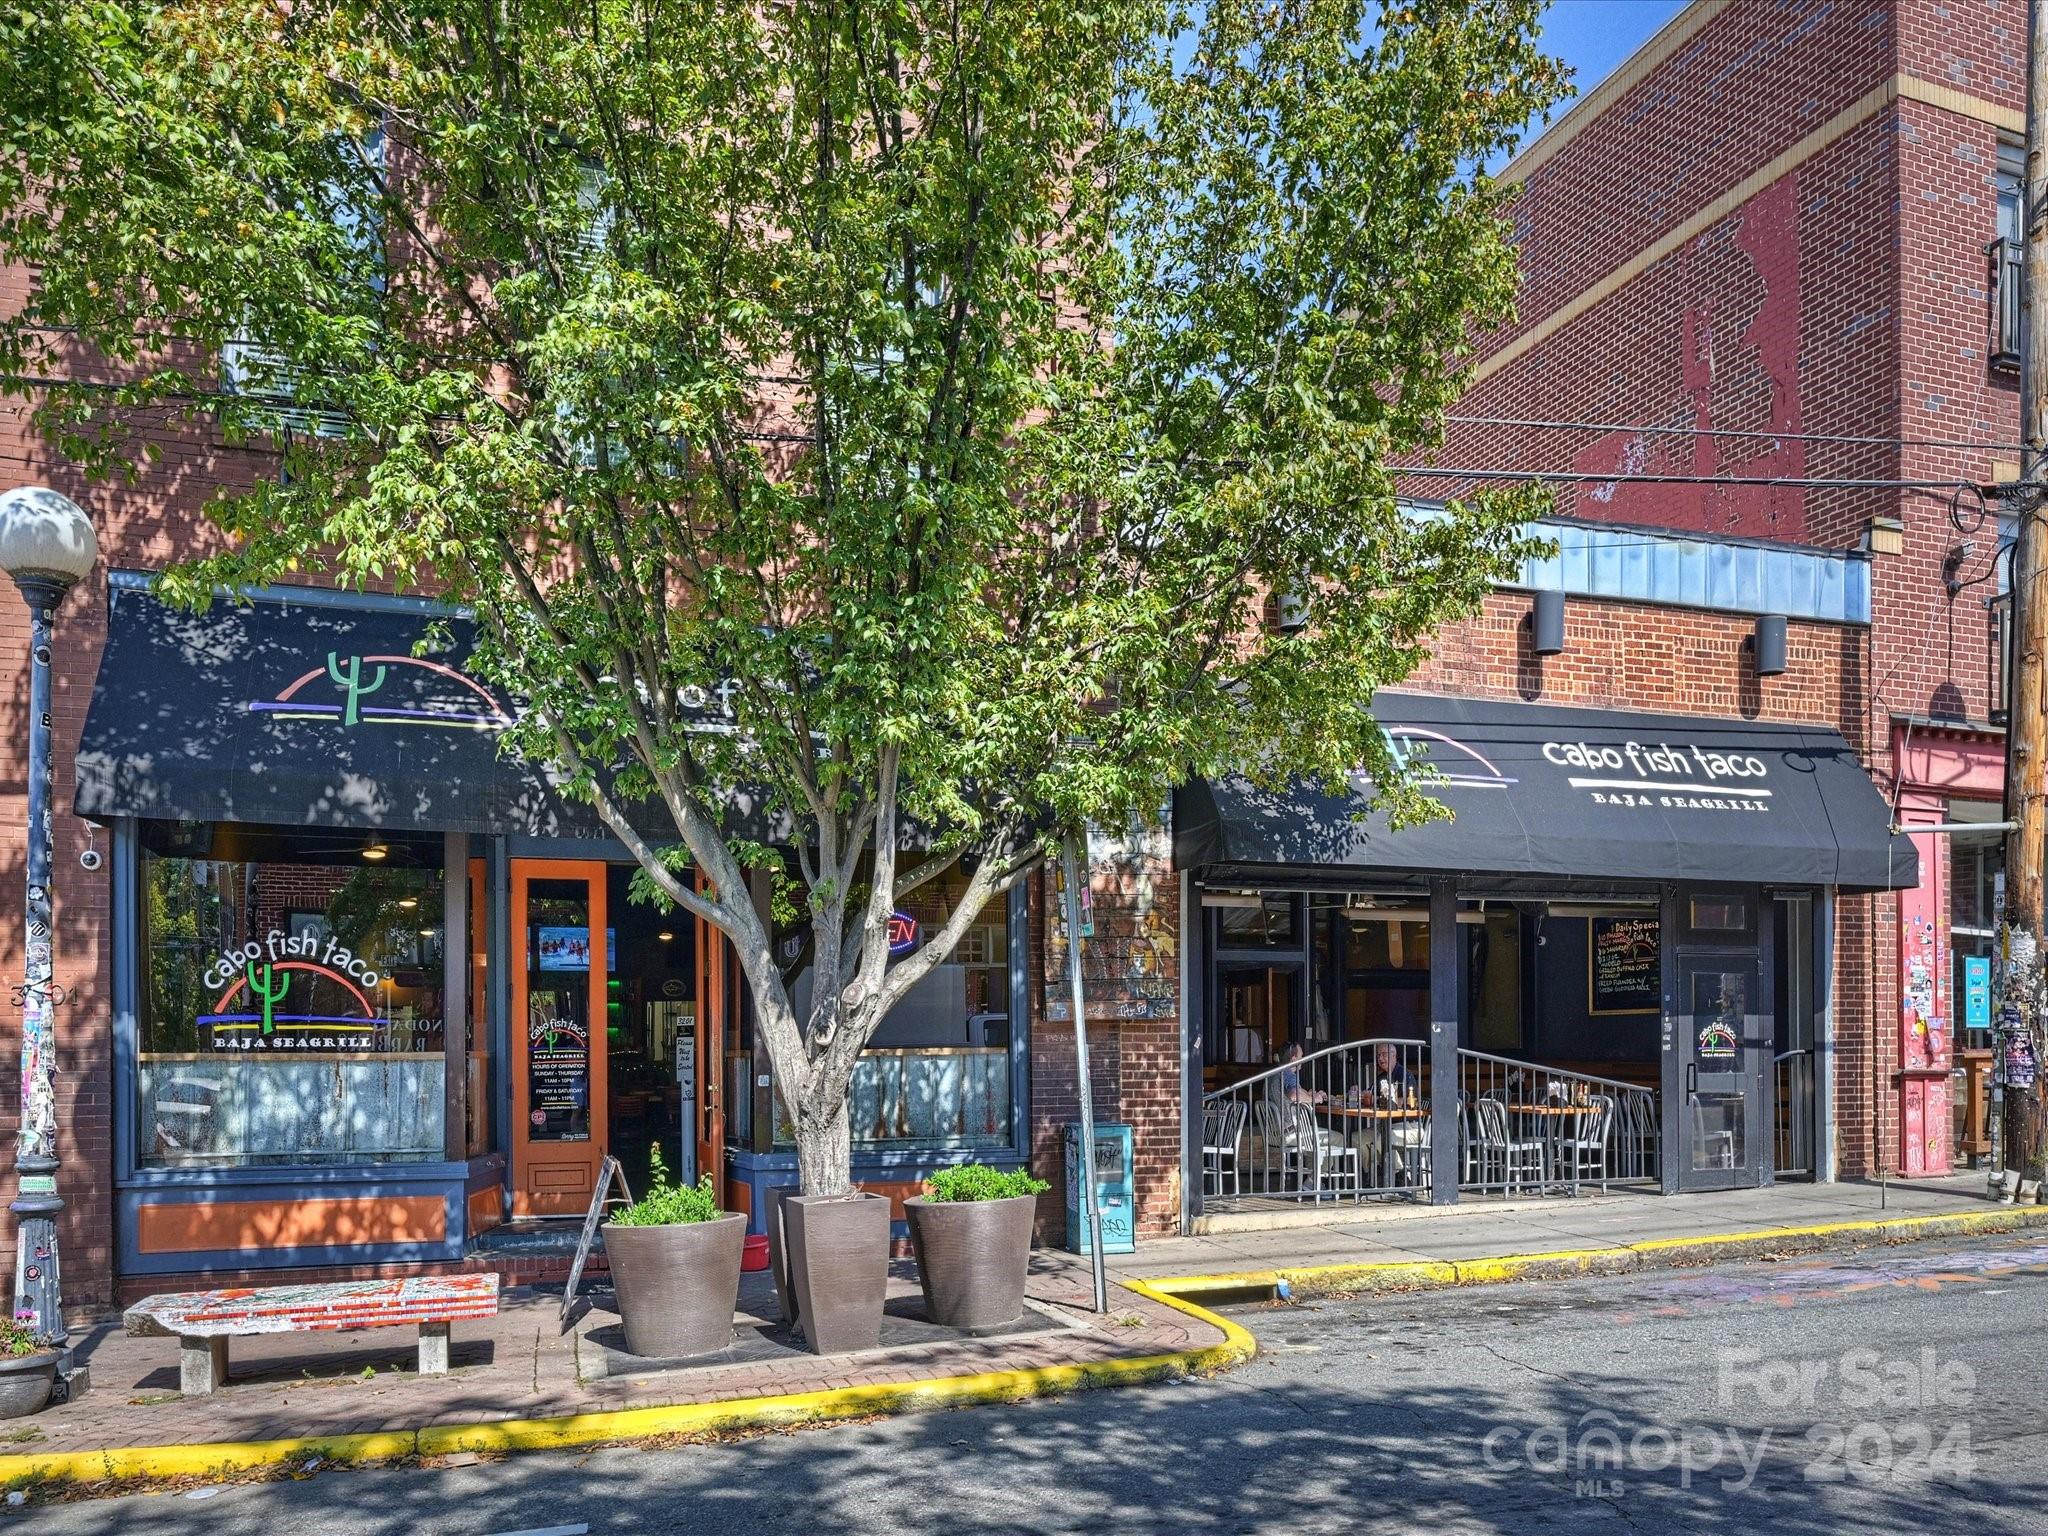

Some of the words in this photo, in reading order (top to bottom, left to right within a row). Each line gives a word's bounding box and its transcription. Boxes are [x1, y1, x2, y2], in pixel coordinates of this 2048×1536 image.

[1625, 741, 1693, 776] fish
[1690, 744, 1768, 779] taco
[1591, 792, 1653, 807] BAJA
[1660, 796, 1769, 811] SEAGRILL
[888, 920, 916, 942] EN
[1615, 921, 1632, 935] Daily
[1633, 920, 1659, 932] Specia
[266, 929, 318, 961] fish
[322, 936, 379, 988] taco
[11, 985, 78, 1006] 301
[549, 1018, 567, 1030] fish
[568, 1019, 587, 1038] taco
[214, 1037, 267, 1048] BAJA
[273, 1036, 372, 1048] SEAGRILL
